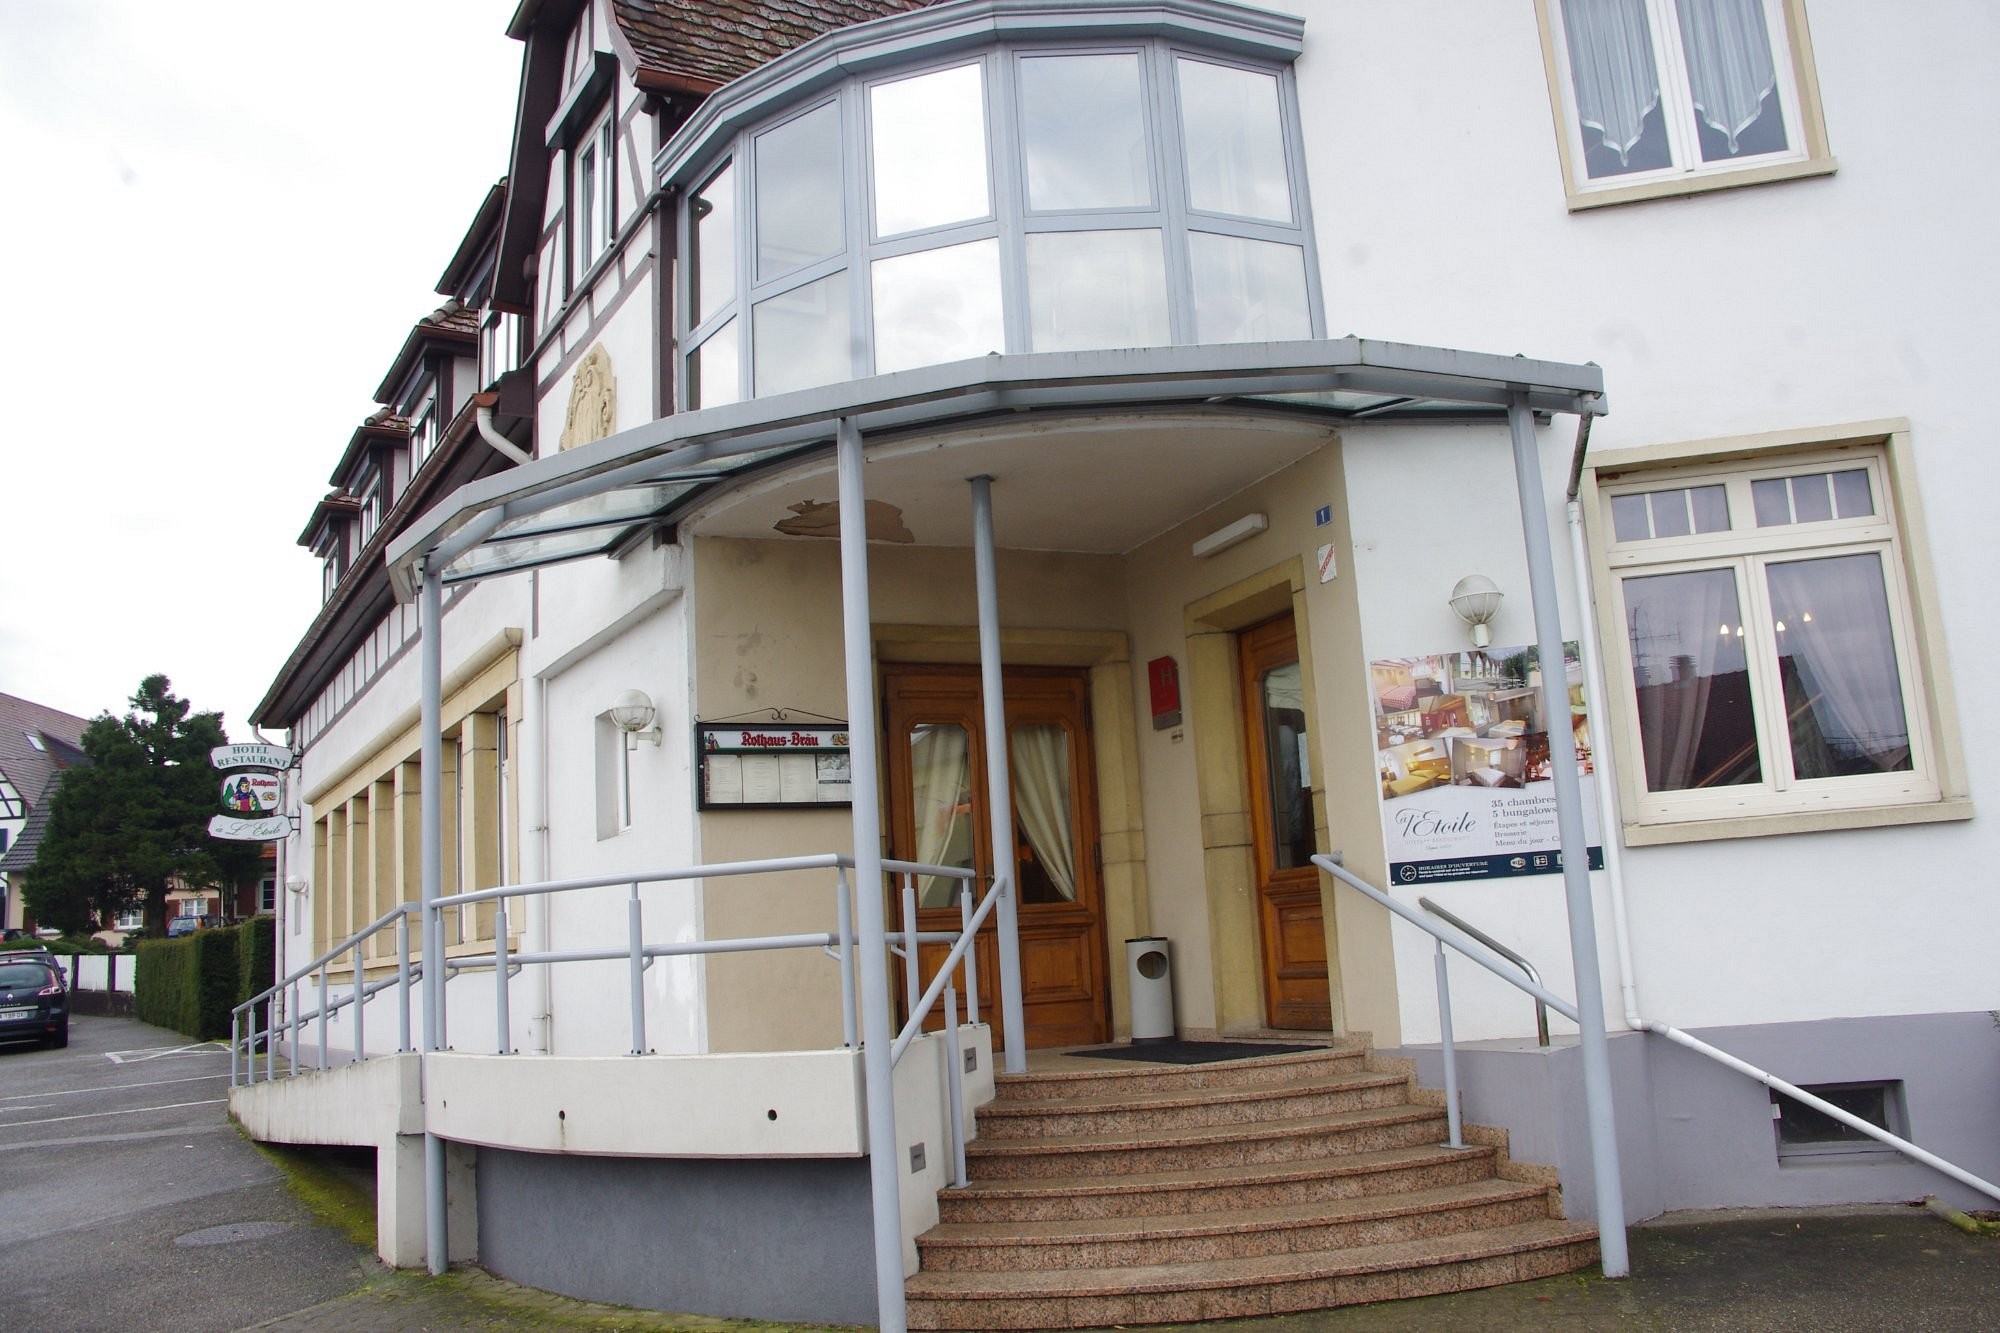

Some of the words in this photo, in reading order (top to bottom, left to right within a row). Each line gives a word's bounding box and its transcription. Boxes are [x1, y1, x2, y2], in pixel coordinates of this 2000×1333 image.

[1321, 510, 1325, 523] 1
[741, 731, 819, 748] Rothaus-Bräu
[233, 746, 269, 754] HOTEL
[218, 756, 288, 767] RESTAURANT
[252, 778, 277, 787] Rothaus
[1491, 799, 1504, 808] 35
[1507, 796, 1557, 807] chambres
[1493, 810, 1498, 818] 5
[1502, 806, 1558, 818] bungalows
[1495, 839, 1516, 848] Menu
[1517, 838, 1528, 846] du
[1529, 837, 1544, 846] jour
